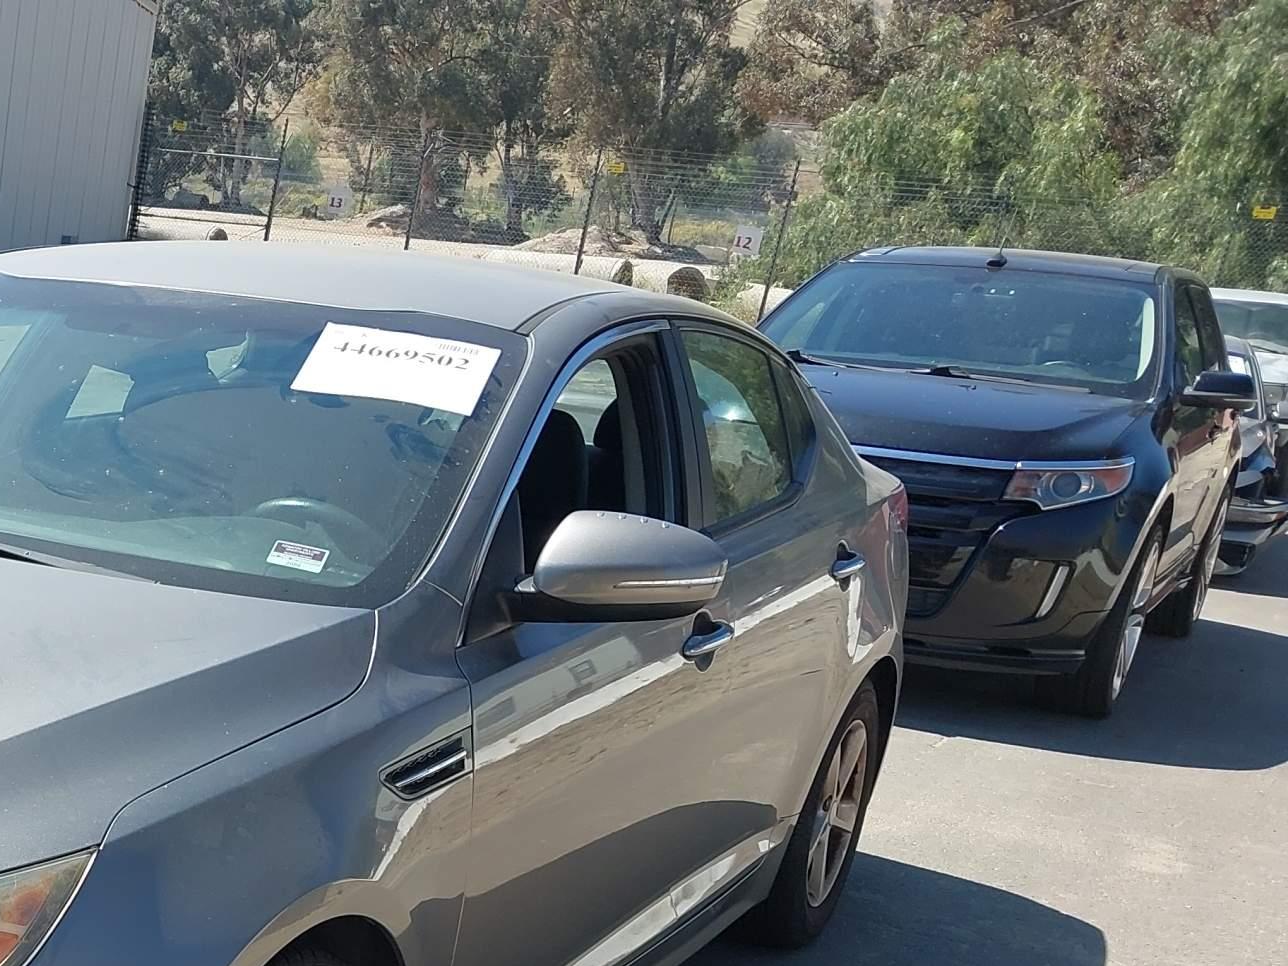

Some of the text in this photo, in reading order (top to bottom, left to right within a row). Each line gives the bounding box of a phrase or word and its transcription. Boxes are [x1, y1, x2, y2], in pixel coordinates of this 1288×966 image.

[330, 197, 343, 208] 13
[735, 236, 752, 250] 12
[333, 341, 470, 370] 44669502
